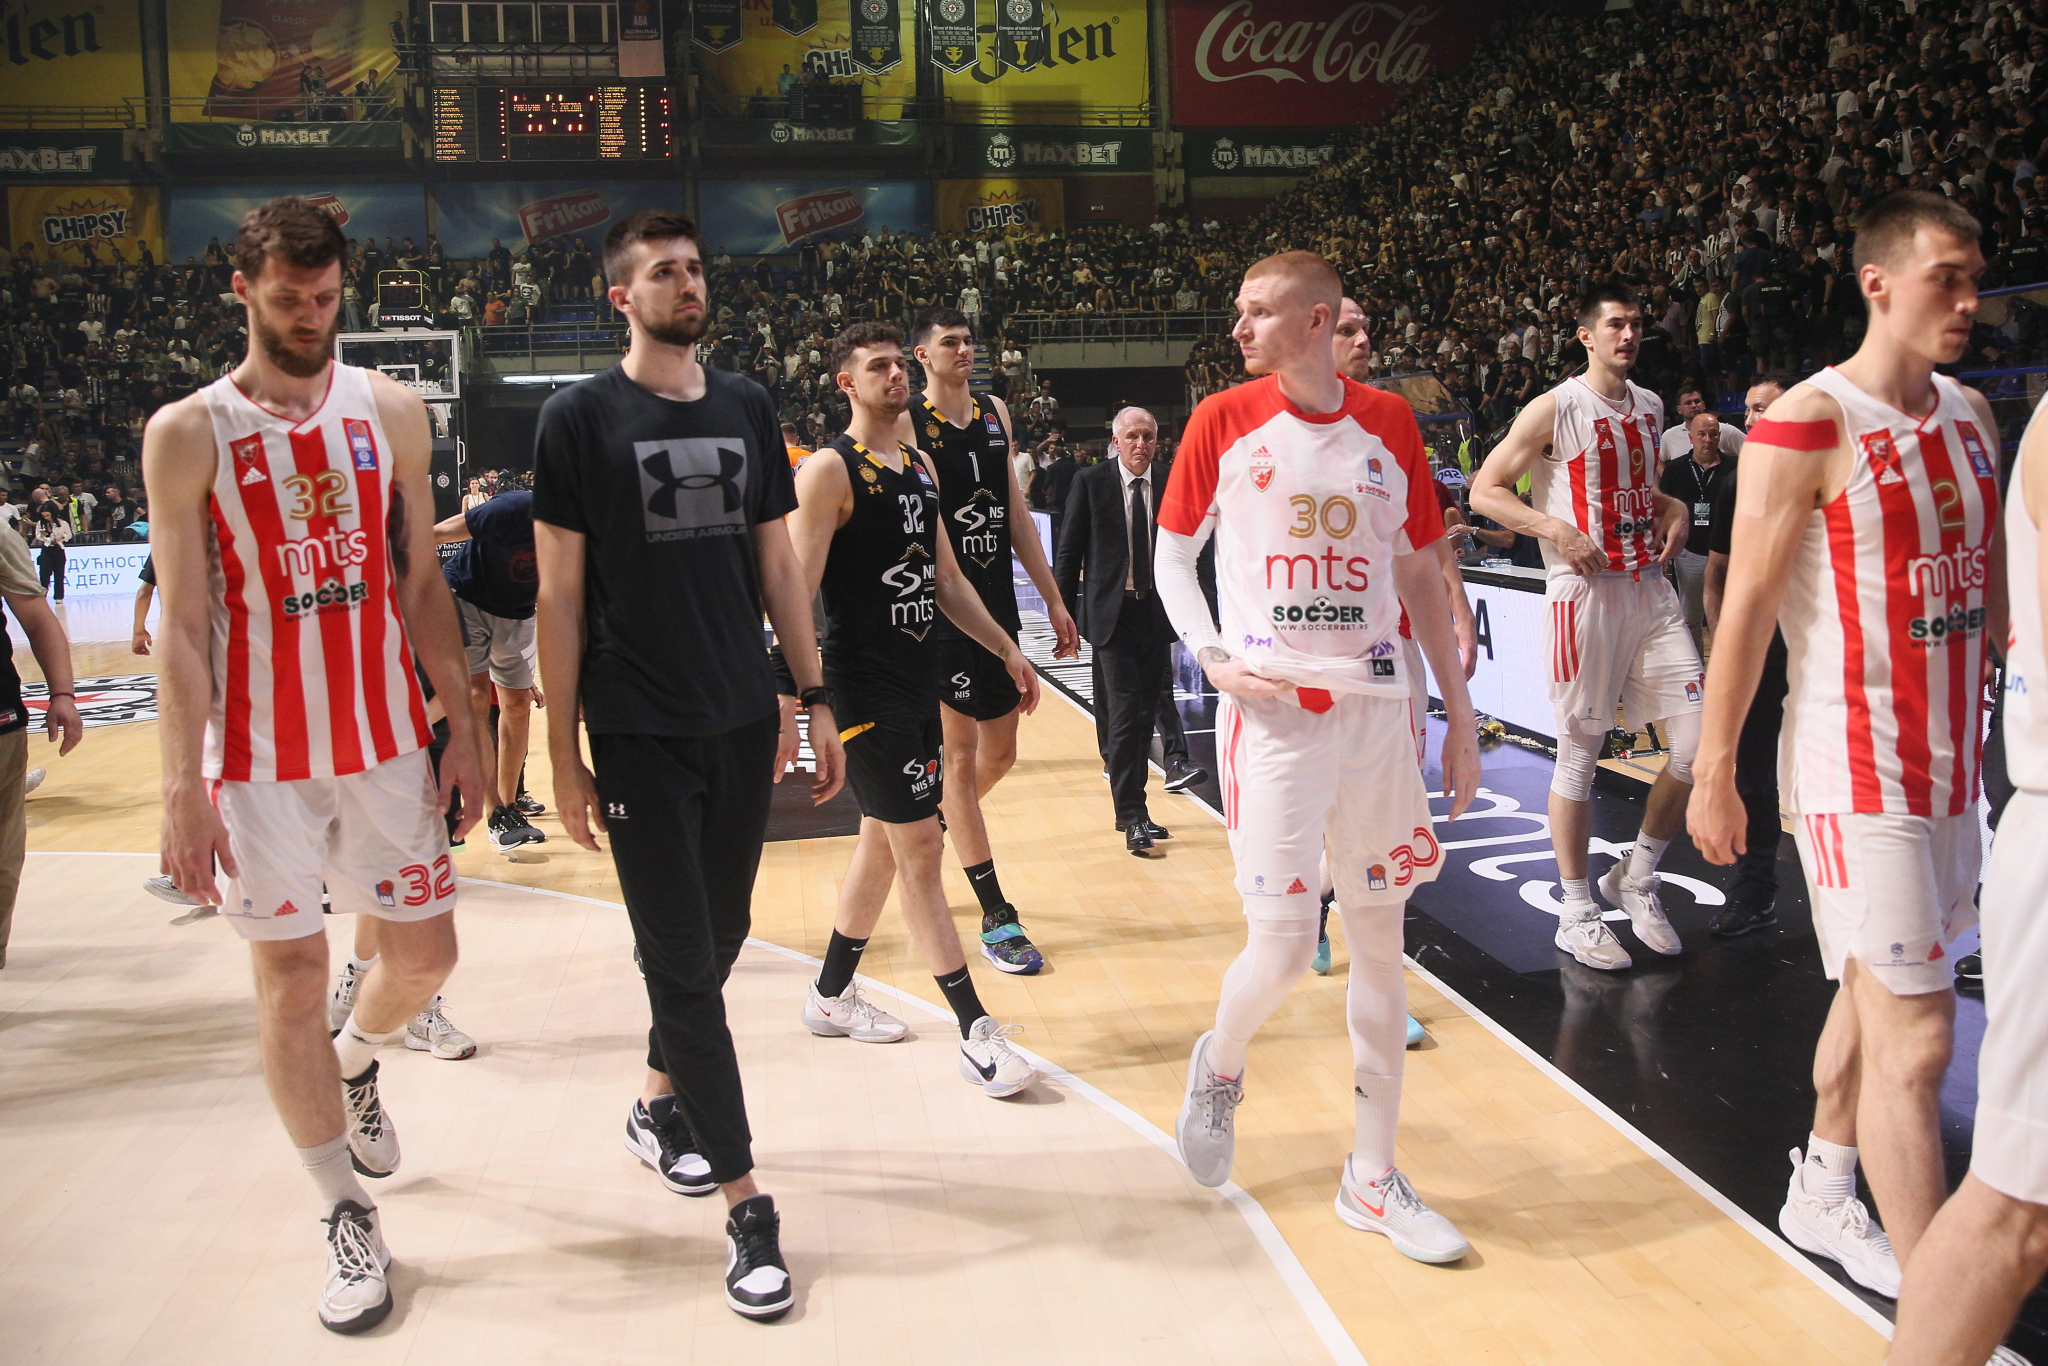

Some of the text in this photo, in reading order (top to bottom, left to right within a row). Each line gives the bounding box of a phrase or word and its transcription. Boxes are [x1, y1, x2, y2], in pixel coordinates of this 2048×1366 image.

[0, 12, 102, 66] len
[971, 21, 1116, 84] Jlen
[1195, 0, 1442, 84] Coca-Cola
[0, 146, 97, 173] AXBET
[1021, 141, 1122, 166] MAXBET
[526, 194, 607, 237] Frikom
[783, 194, 859, 235] Frikom
[968, 451, 980, 482] 1
[1631, 448, 1644, 475] 9
[282, 469, 353, 521] 32
[1932, 478, 1965, 531] 2
[898, 494, 924, 533] 32
[1288, 494, 1357, 540] 30
[276, 526, 368, 577] mts
[647, 529, 695, 543] UNDER
[962, 530, 997, 554] mts
[76, 573, 120, 589] ДЕЛУ
[923, 564, 936, 579] NI
[1266, 546, 1369, 592] mts
[1908, 543, 1987, 597] mts
[284, 580, 369, 614] SOCCER
[891, 594, 934, 625] mts
[1273, 605, 1365, 623] SOCCER
[1909, 606, 1986, 639] SOCCER
[954, 689, 971, 699] NIS
[911, 780, 928, 793] NIS
[1388, 827, 1439, 886] 30
[398, 854, 456, 907] 32
[1370, 879, 1386, 889] ABA
